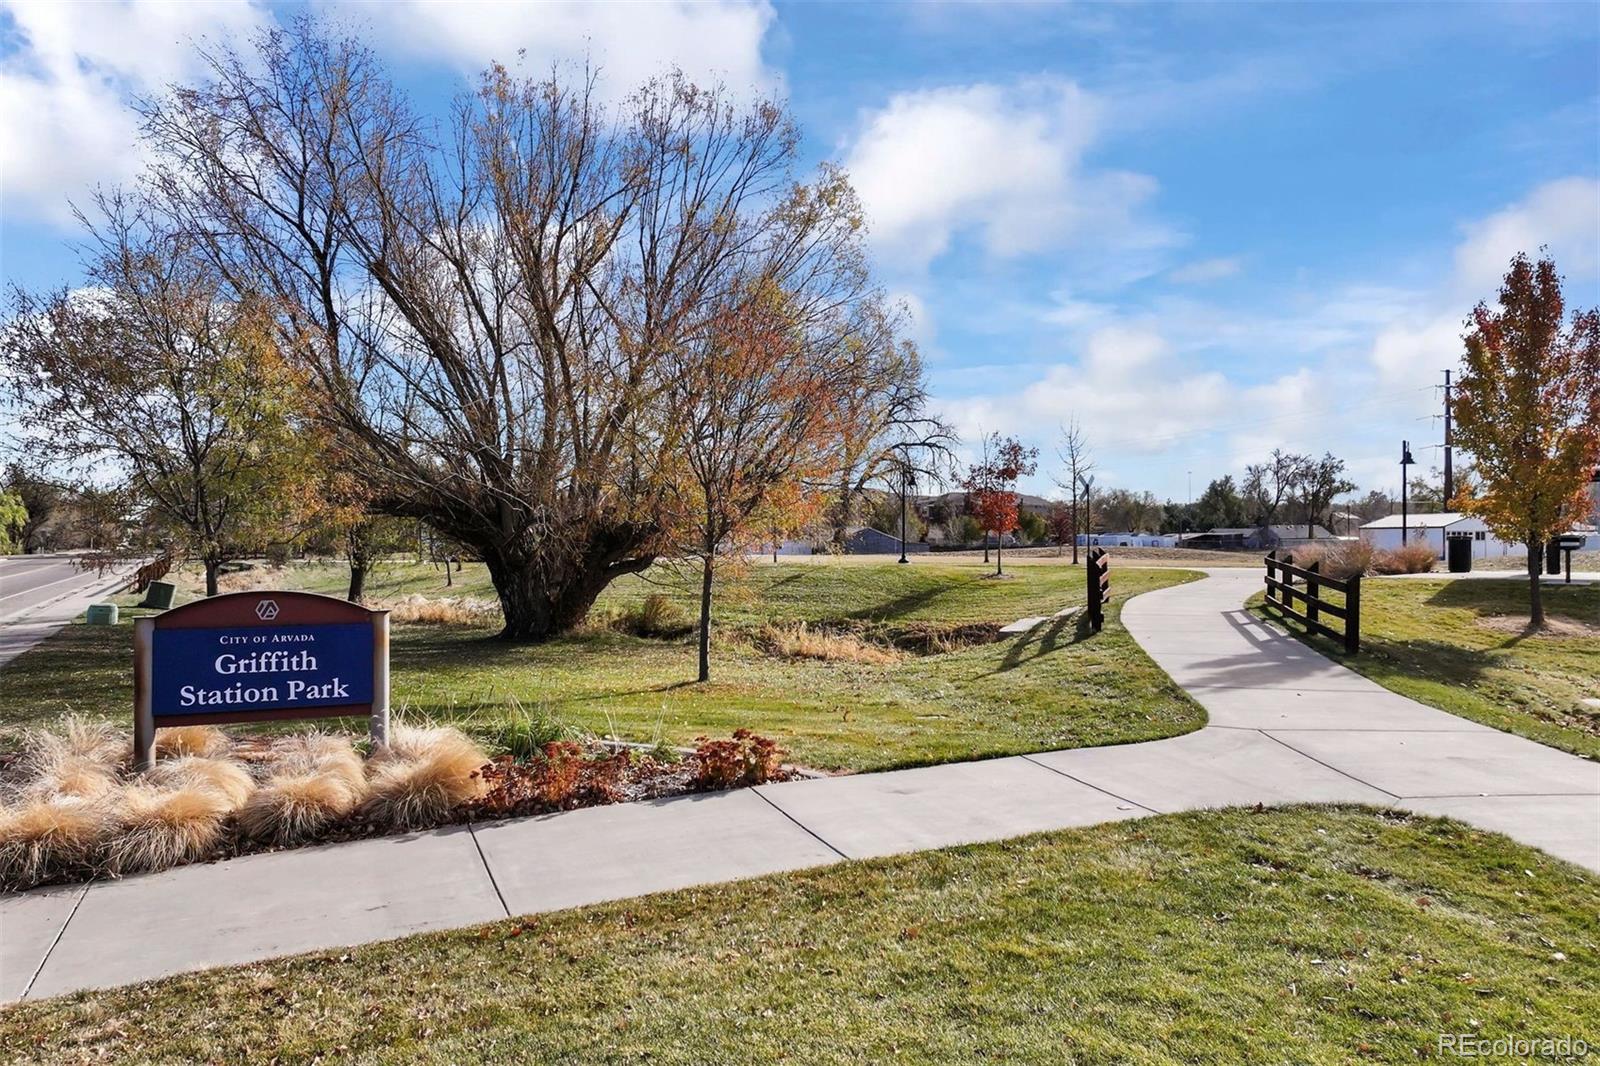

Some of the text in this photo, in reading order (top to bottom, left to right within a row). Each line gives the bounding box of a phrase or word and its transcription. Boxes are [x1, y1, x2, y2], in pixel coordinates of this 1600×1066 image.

[219, 634, 315, 645] CITY OF ARVADA
[214, 650, 318, 675] Griffith
[180, 678, 350, 706] Station Park
